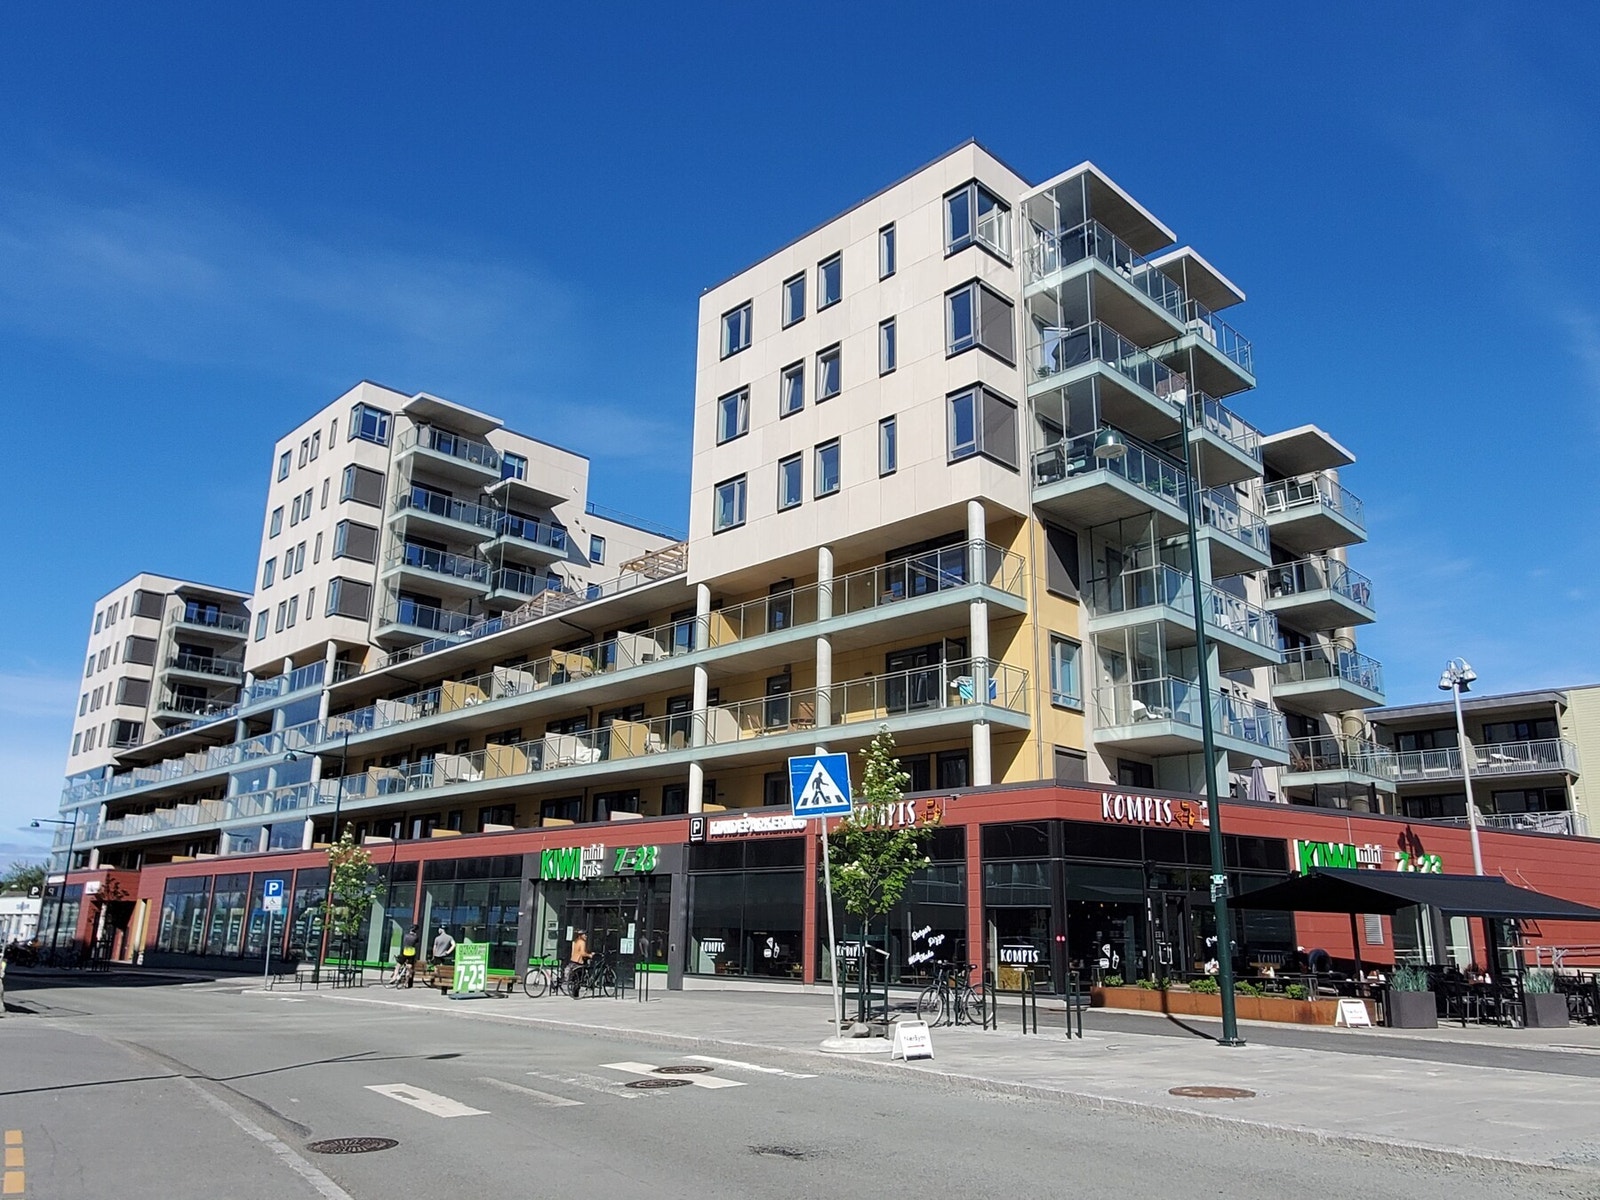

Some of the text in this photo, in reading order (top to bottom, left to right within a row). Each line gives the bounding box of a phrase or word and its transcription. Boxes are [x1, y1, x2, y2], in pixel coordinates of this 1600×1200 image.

[1102, 793, 1172, 824] KOMPIS
[541, 844, 604, 880] KIWI mini
[582, 861, 602, 880] pris
[613, 846, 657, 873] 7-23
[1293, 839, 1382, 877] KIWI mini
[31, 886, 39, 895] P
[269, 882, 279, 895] P
[1000, 949, 1040, 963] KOMPIS
[457, 964, 485, 991] 7-23
